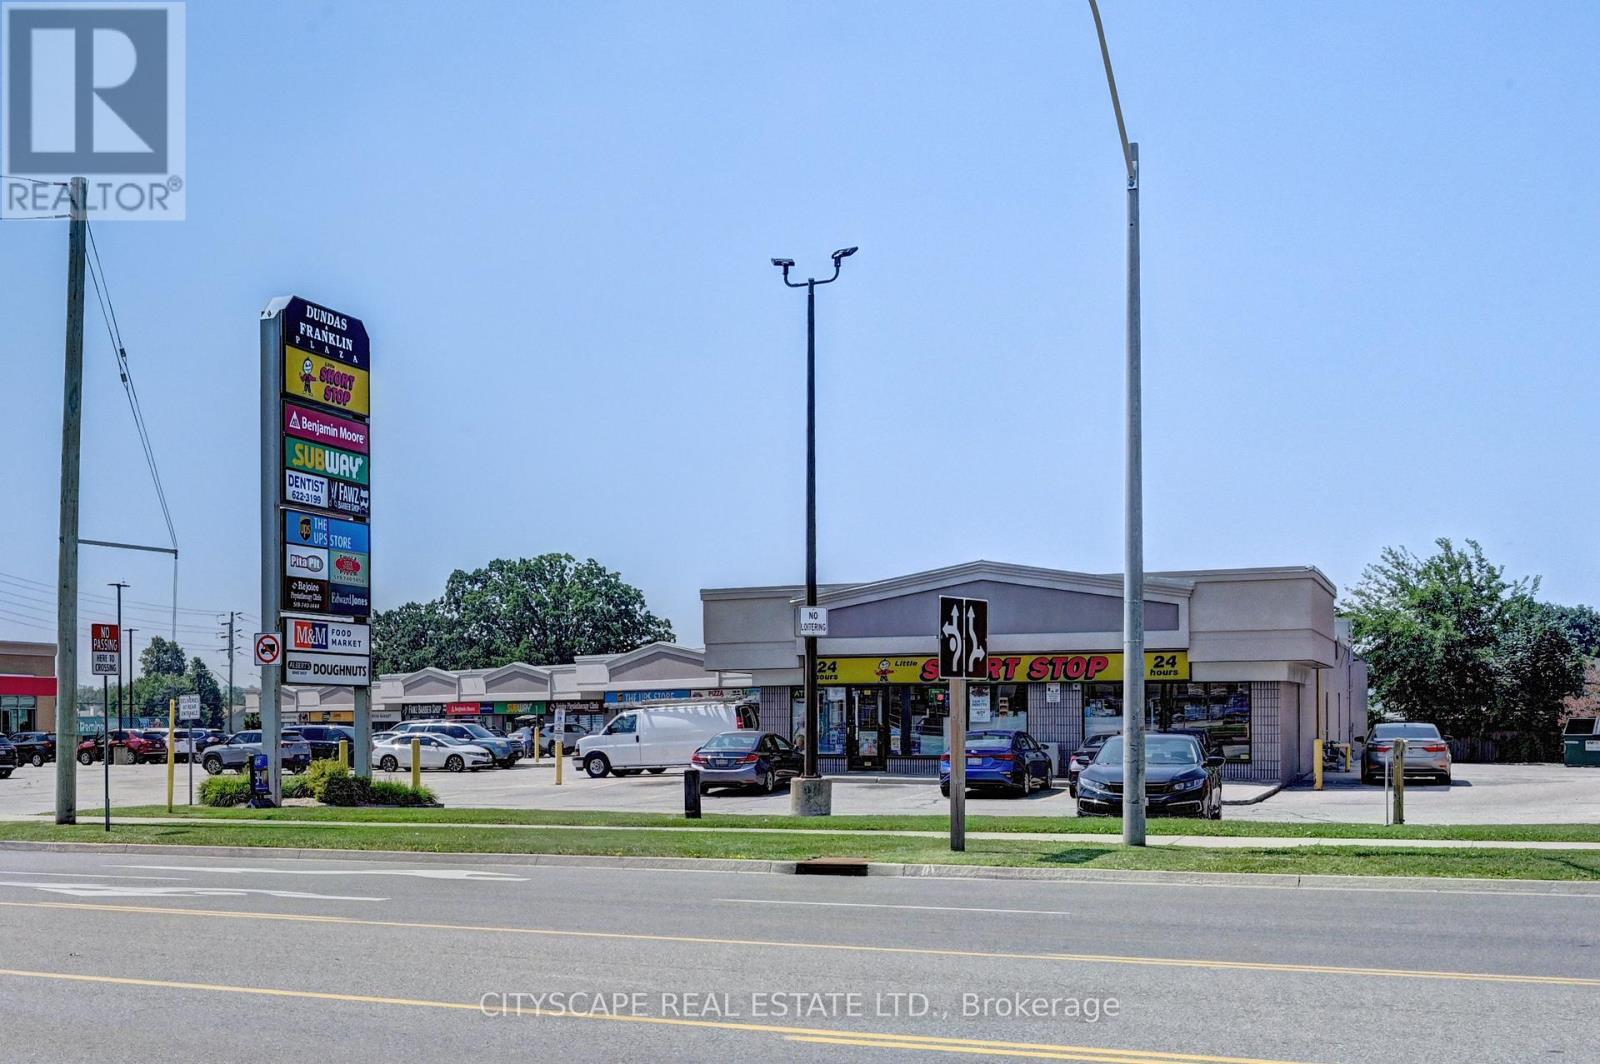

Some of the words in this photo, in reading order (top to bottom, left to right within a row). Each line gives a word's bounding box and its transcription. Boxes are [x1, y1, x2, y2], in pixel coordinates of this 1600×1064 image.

[305, 305, 348, 331] DUNDAS
[299, 321, 353, 352] FRANKLIN
[319, 366, 355, 391] SHORT
[323, 385, 352, 406] STOP
[301, 416, 338, 437] Benjamin
[339, 427, 364, 444] Moore
[292, 443, 363, 479] SUBWAY
[288, 474, 325, 495] DENTIST
[291, 490, 322, 505] 622-3199
[313, 517, 327, 531] THE
[313, 531, 328, 545] UPS
[329, 535, 352, 549] STORE
[291, 554, 307, 569] Pita
[308, 558, 321, 570] Pit
[297, 580, 319, 593] Rejoice
[808, 611, 819, 620] NO
[100, 626, 110, 638] NO
[296, 625, 326, 645] M&M
[331, 628, 352, 637] FOOD
[801, 624, 826, 632] LOITERING
[93, 638, 118, 651] PASSING
[331, 638, 362, 648] MARKET
[96, 654, 107, 663] HERE
[109, 655, 116, 663] TO
[95, 663, 117, 672] CROSSING
[313, 663, 367, 677] DOUGHNUTS
[816, 660, 838, 673] 24
[919, 655, 1021, 681] SRT
[1026, 655, 1109, 681] STOP
[1152, 655, 1178, 669] 24
[1149, 668, 1179, 676] hours
[624, 693, 637, 703] THE
[708, 690, 725, 698] PIZZA
[506, 702, 532, 713] SUBWAY
